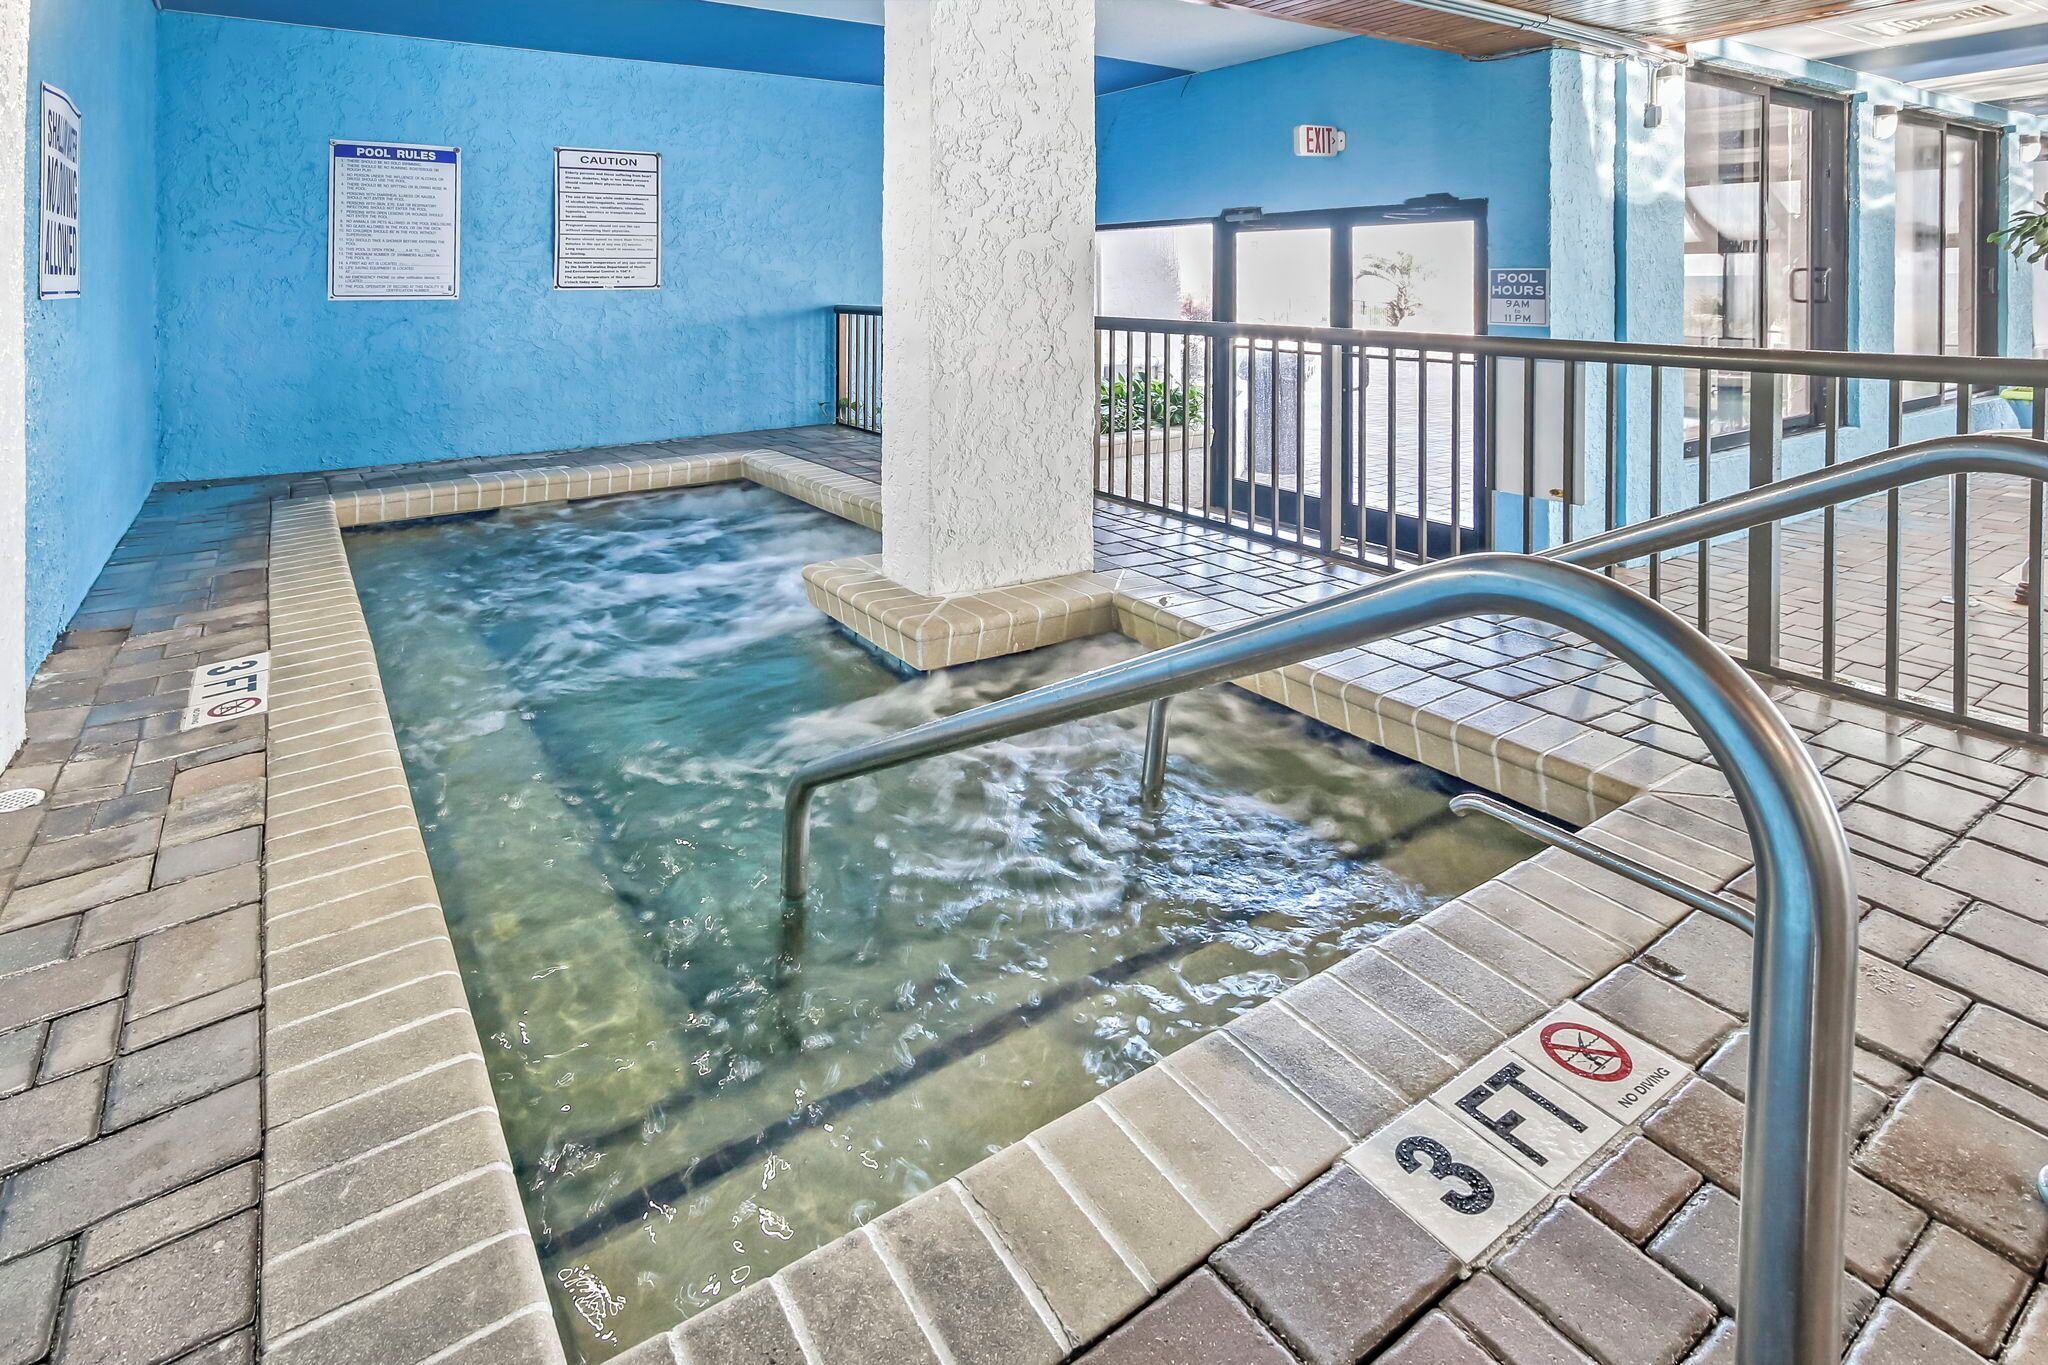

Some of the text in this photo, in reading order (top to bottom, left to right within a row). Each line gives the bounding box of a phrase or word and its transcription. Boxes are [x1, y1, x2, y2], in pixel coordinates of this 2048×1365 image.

[356, 147, 436, 160] POOL RULES
[1306, 126, 1332, 154] EXIT
[580, 155, 638, 167] CAUTION
[44, 220, 77, 276] ALLOWED
[1492, 285, 1544, 296] HOURS
[1497, 273, 1538, 283] POOL
[202, 660, 258, 699] 3 FT
[1618, 1067, 1671, 1108] NO DIVING
[1394, 1062, 1588, 1215] 3 FT
